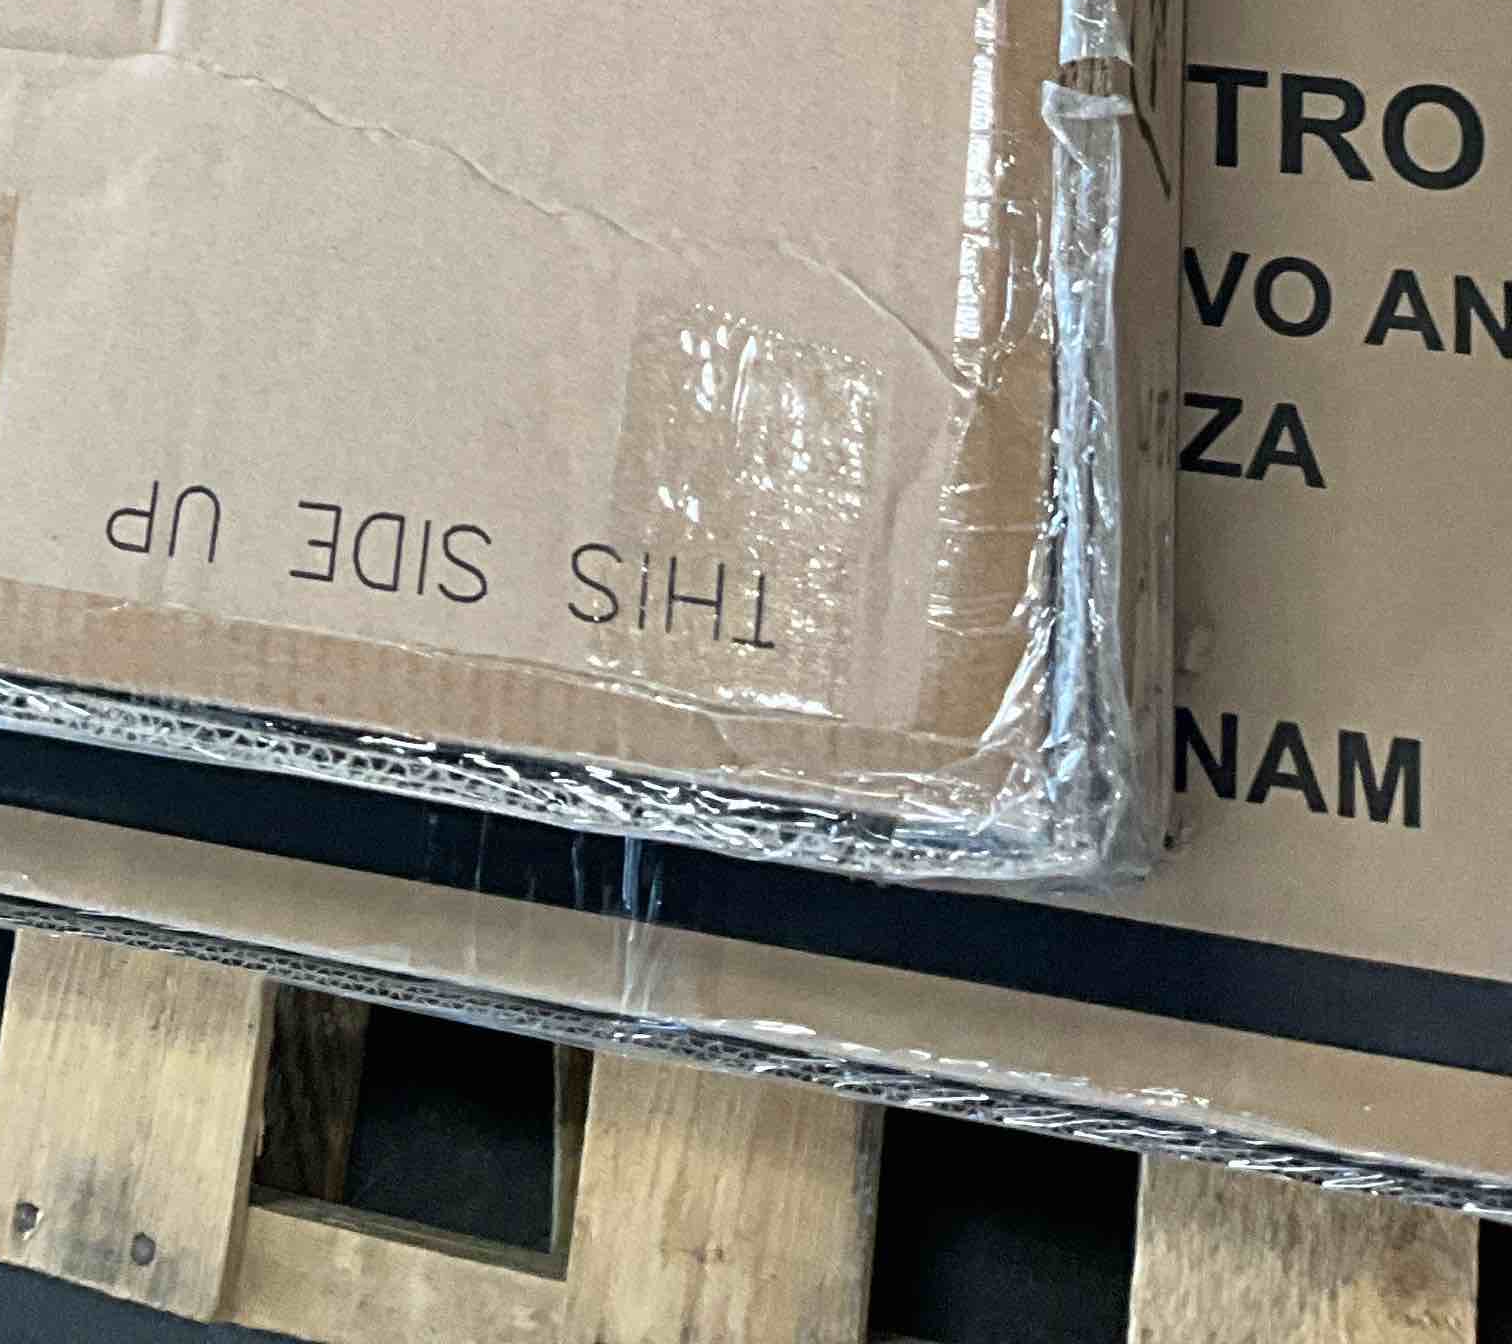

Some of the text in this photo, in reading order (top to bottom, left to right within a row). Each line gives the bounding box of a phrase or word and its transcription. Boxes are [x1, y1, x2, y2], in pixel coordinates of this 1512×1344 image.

[103, 480, 777, 650] THIS SIDE UP
